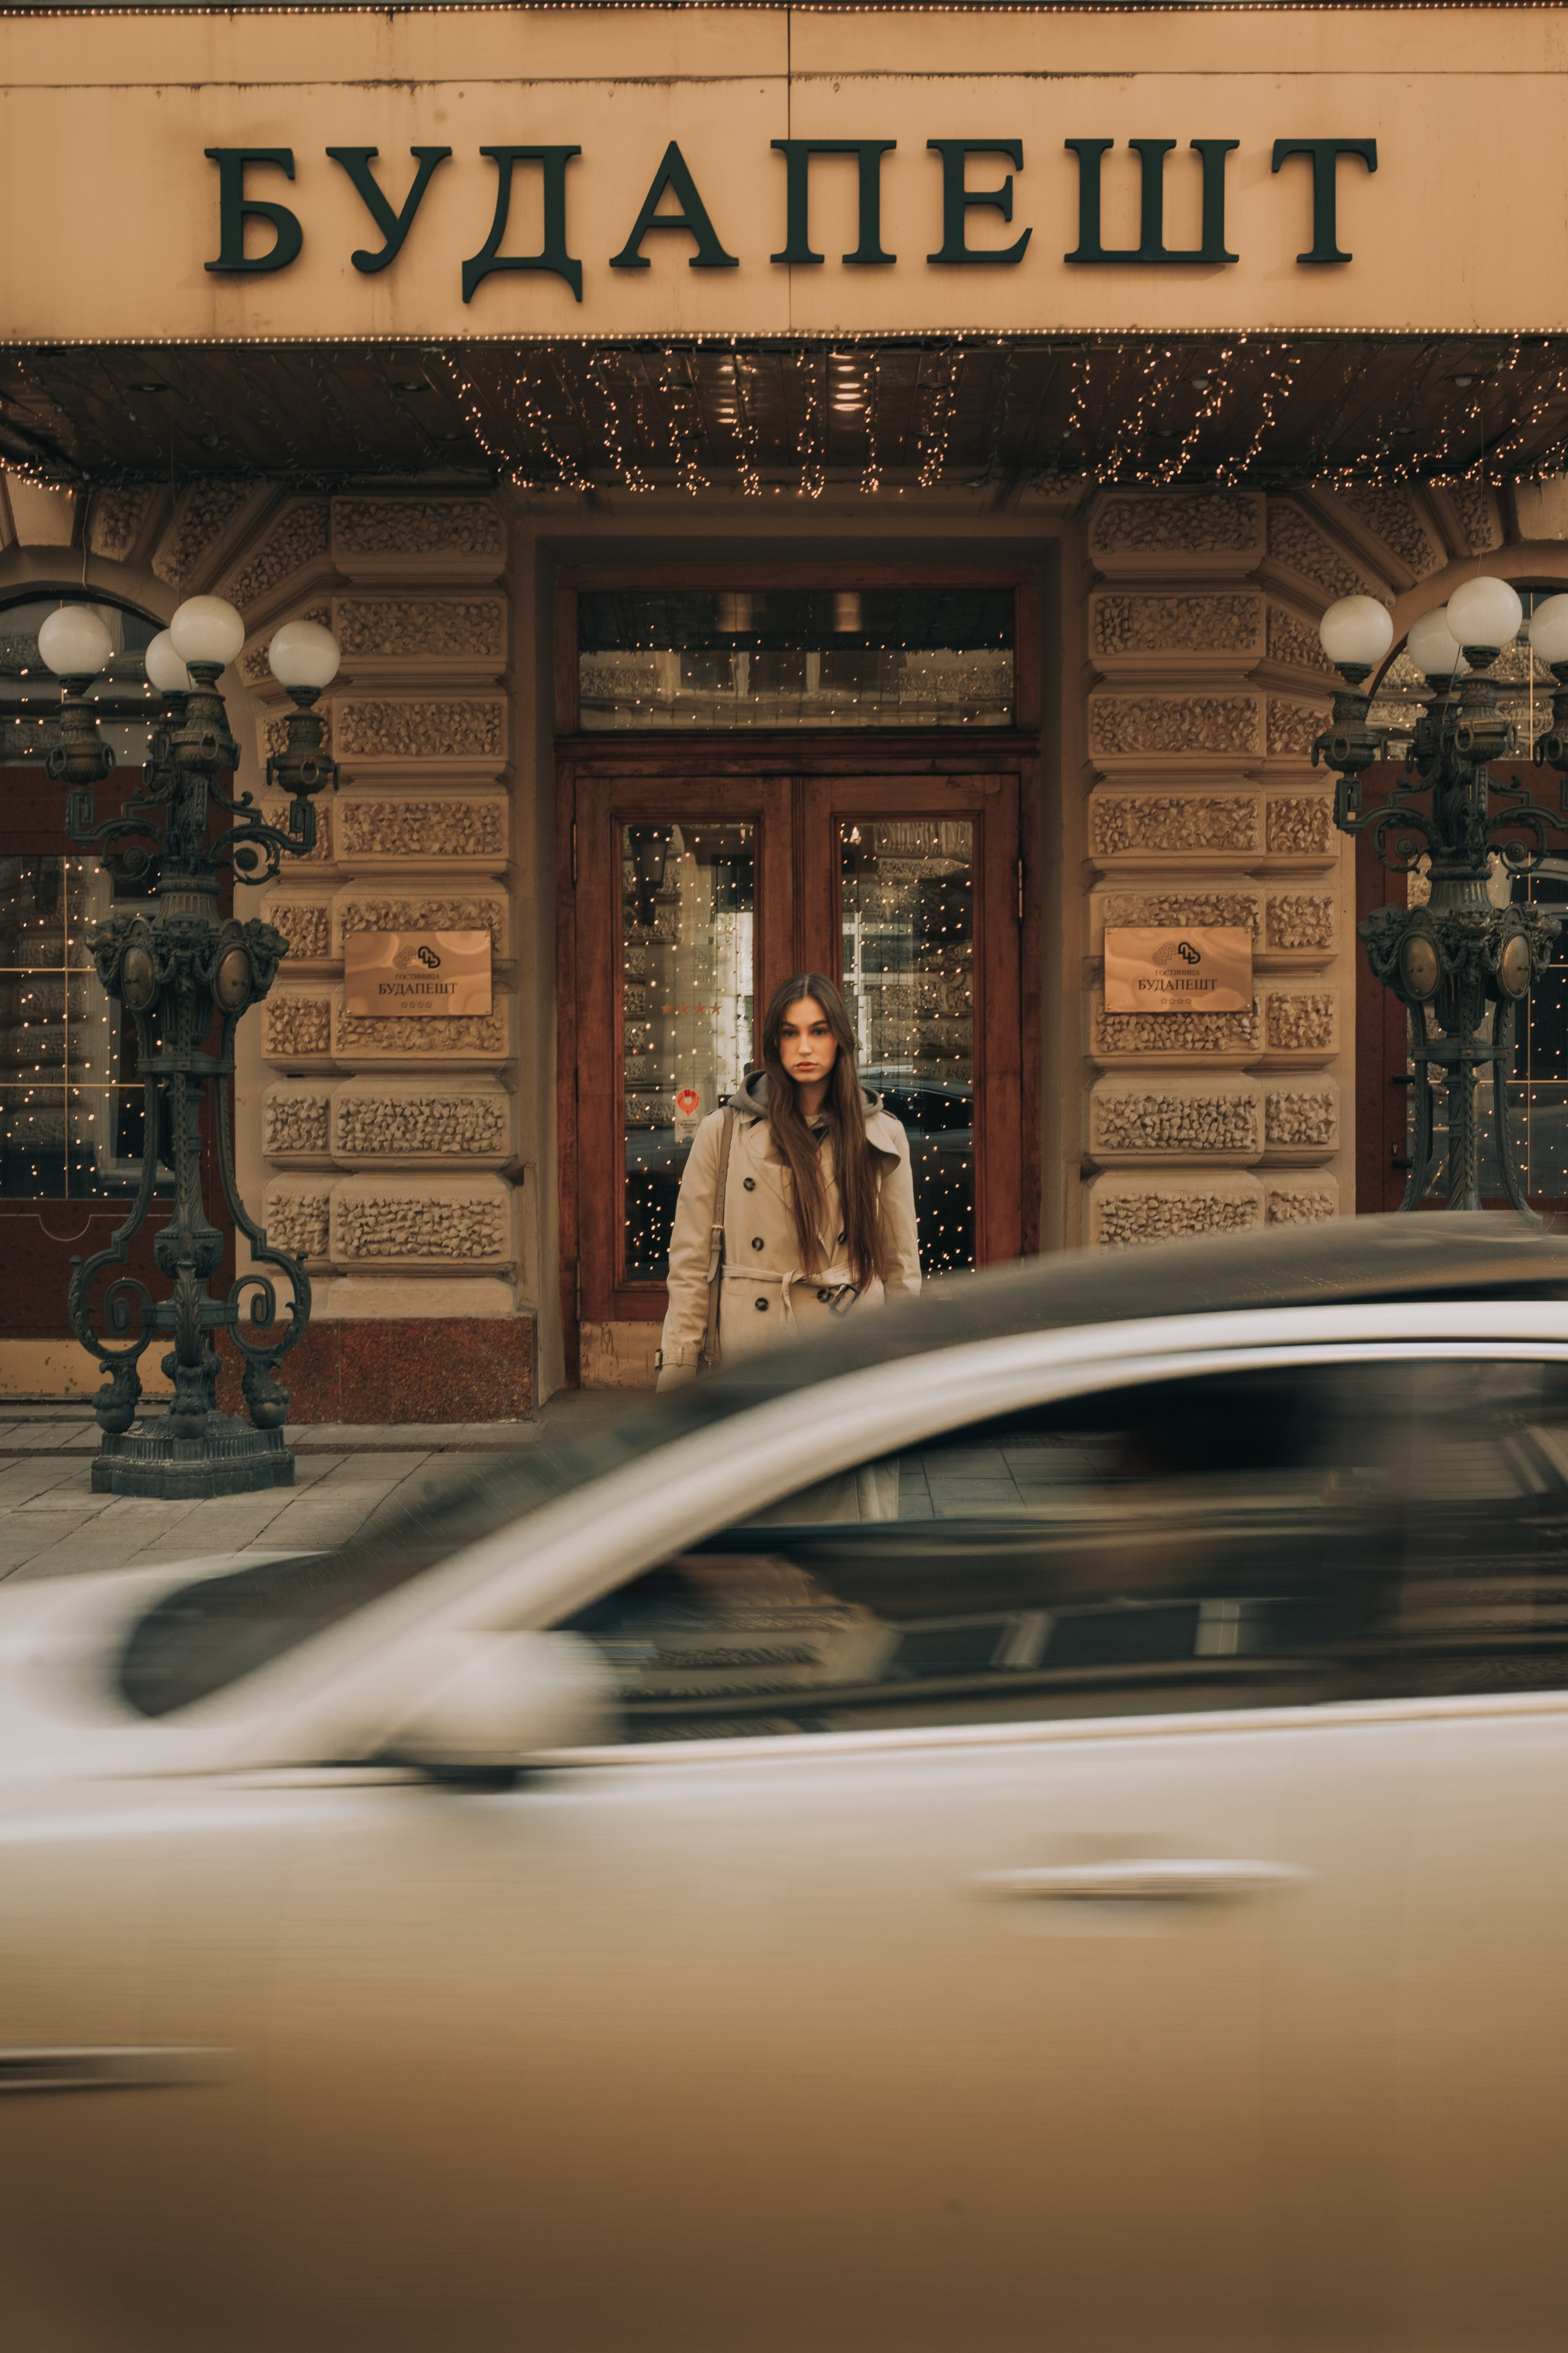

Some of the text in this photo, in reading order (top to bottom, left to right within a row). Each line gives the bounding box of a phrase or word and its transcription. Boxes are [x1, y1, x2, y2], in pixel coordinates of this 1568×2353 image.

[204, 137, 1378, 304] БУДАПЕШТ
[379, 982, 458, 996] БУДАПЕШТ
[1138, 978, 1218, 992] БУДАПЕШТ
